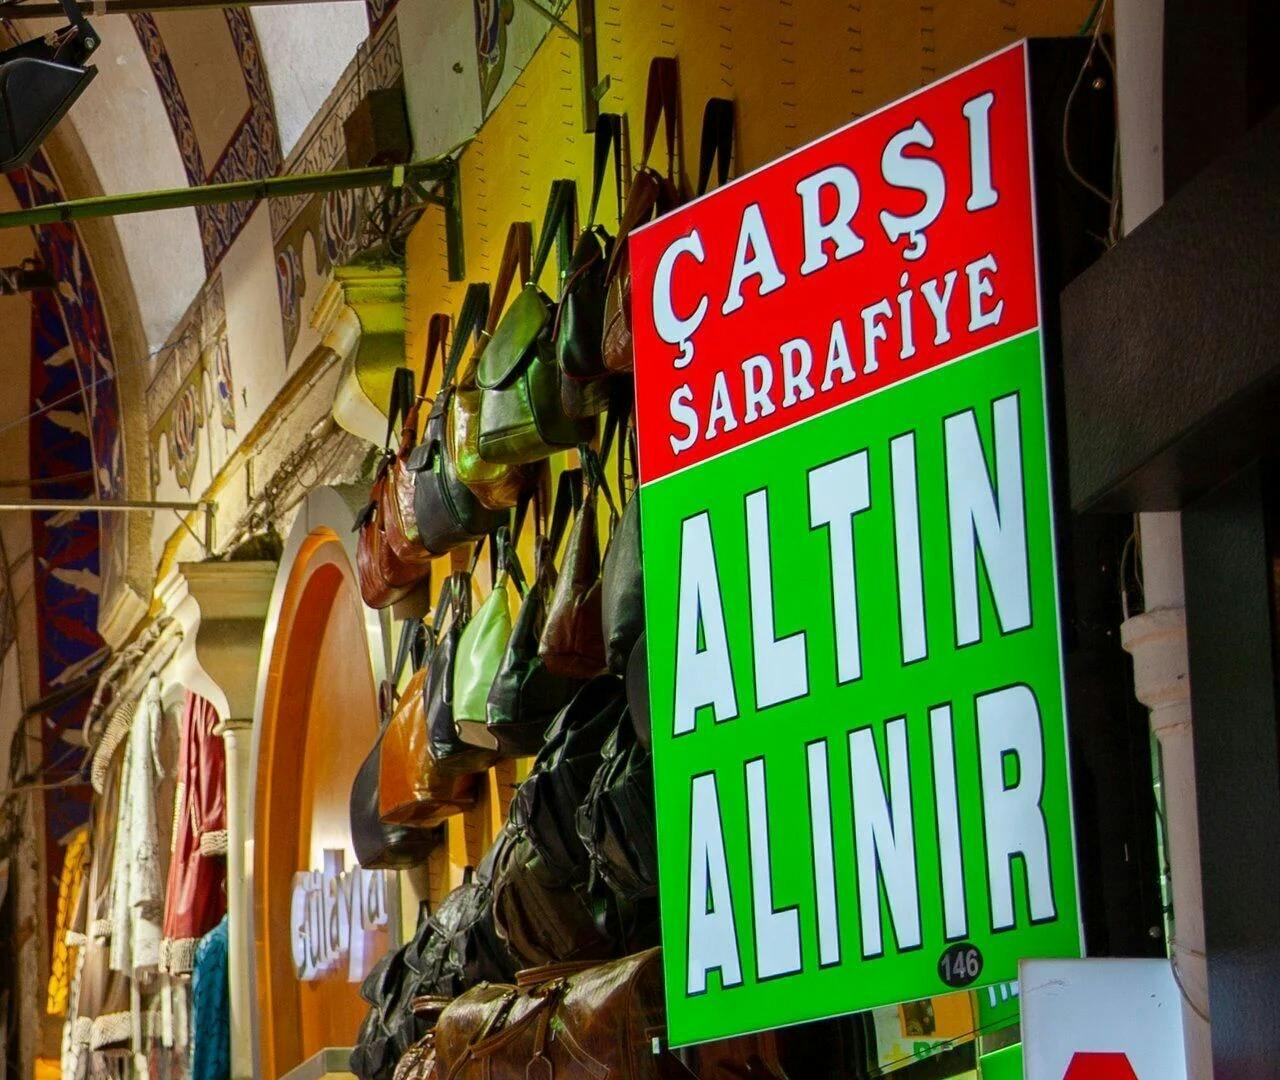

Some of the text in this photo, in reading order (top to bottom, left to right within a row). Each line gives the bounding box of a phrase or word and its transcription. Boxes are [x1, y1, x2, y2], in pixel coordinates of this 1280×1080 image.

[652, 92, 1000, 368] ÇARŞI
[669, 254, 1004, 455] SARRAFİYE
[673, 391, 1033, 738] ALTIN
[685, 681, 1057, 997] ALINIR
[941, 947, 979, 981] 146
